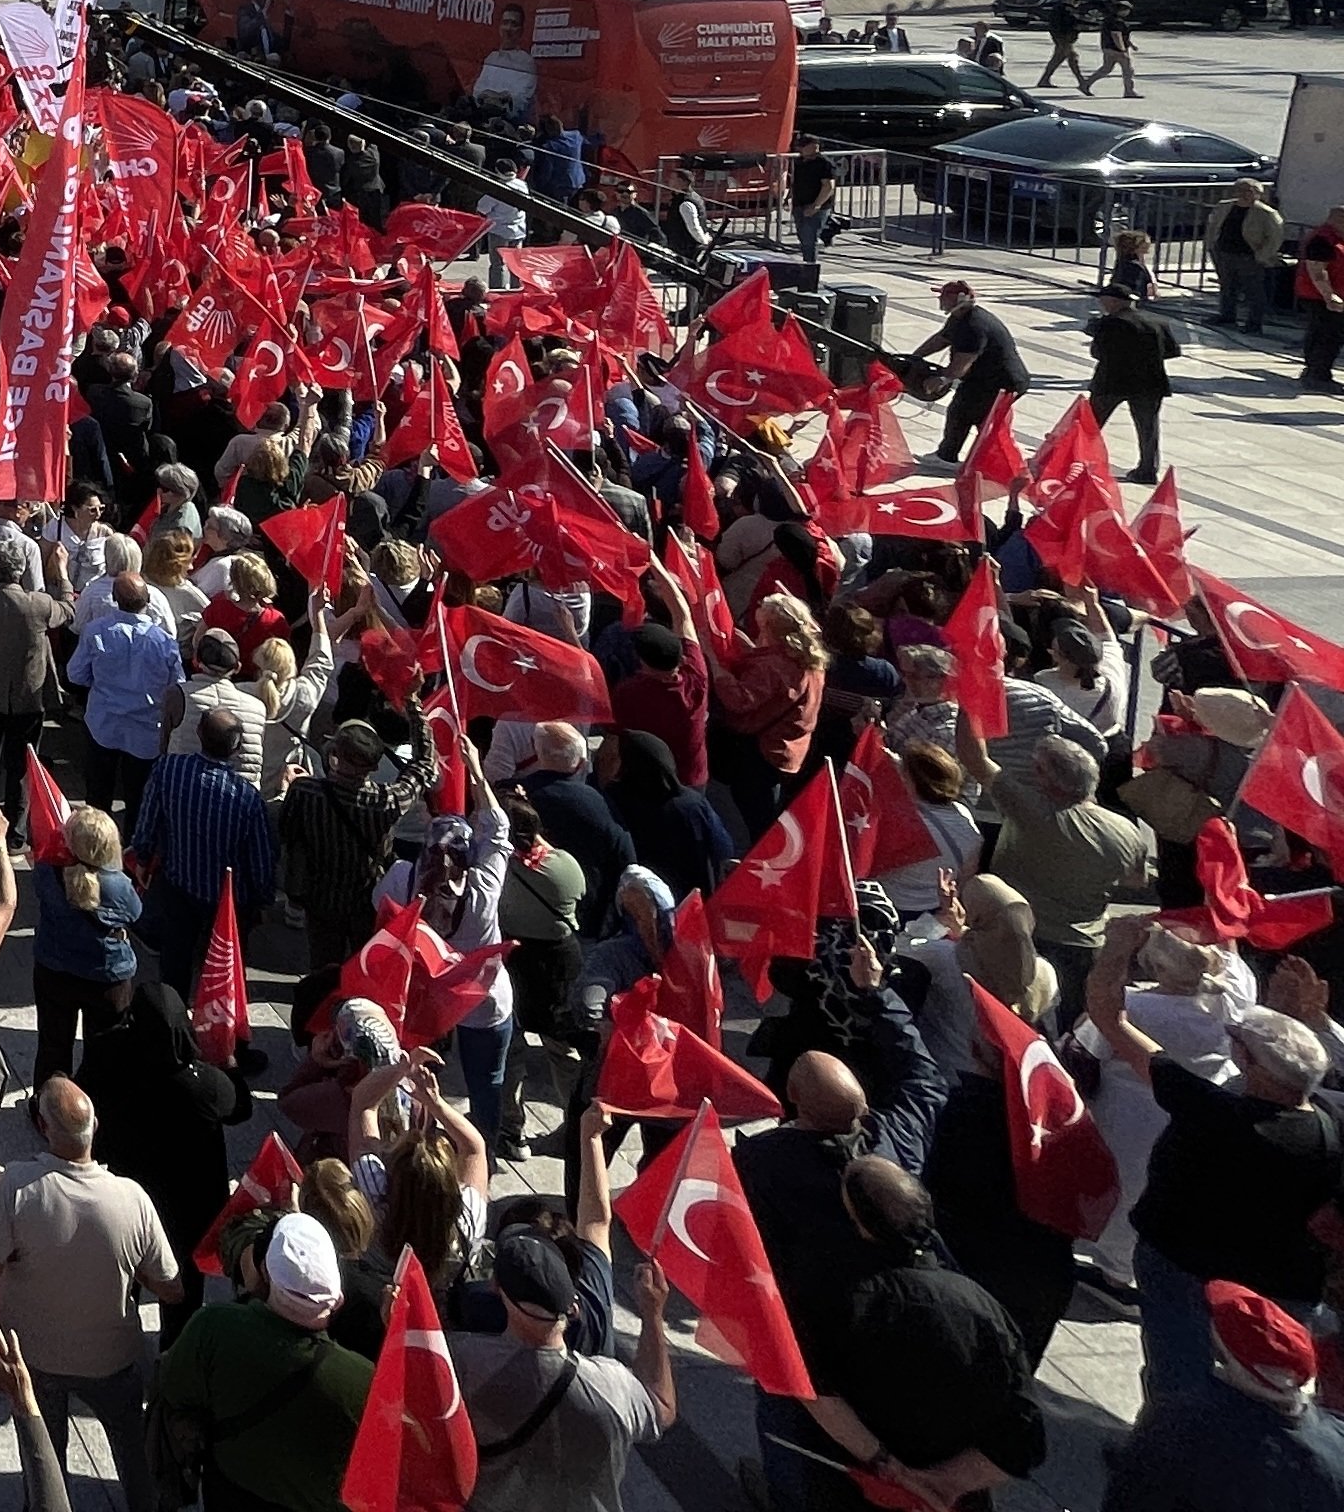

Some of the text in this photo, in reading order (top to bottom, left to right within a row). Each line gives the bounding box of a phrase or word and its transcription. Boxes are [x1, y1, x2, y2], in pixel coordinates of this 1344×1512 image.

[696, 20, 774, 35] CUMHURİYET
[697, 34, 776, 48] HALK PARTİSİ
[186, 296, 215, 332] CHP
